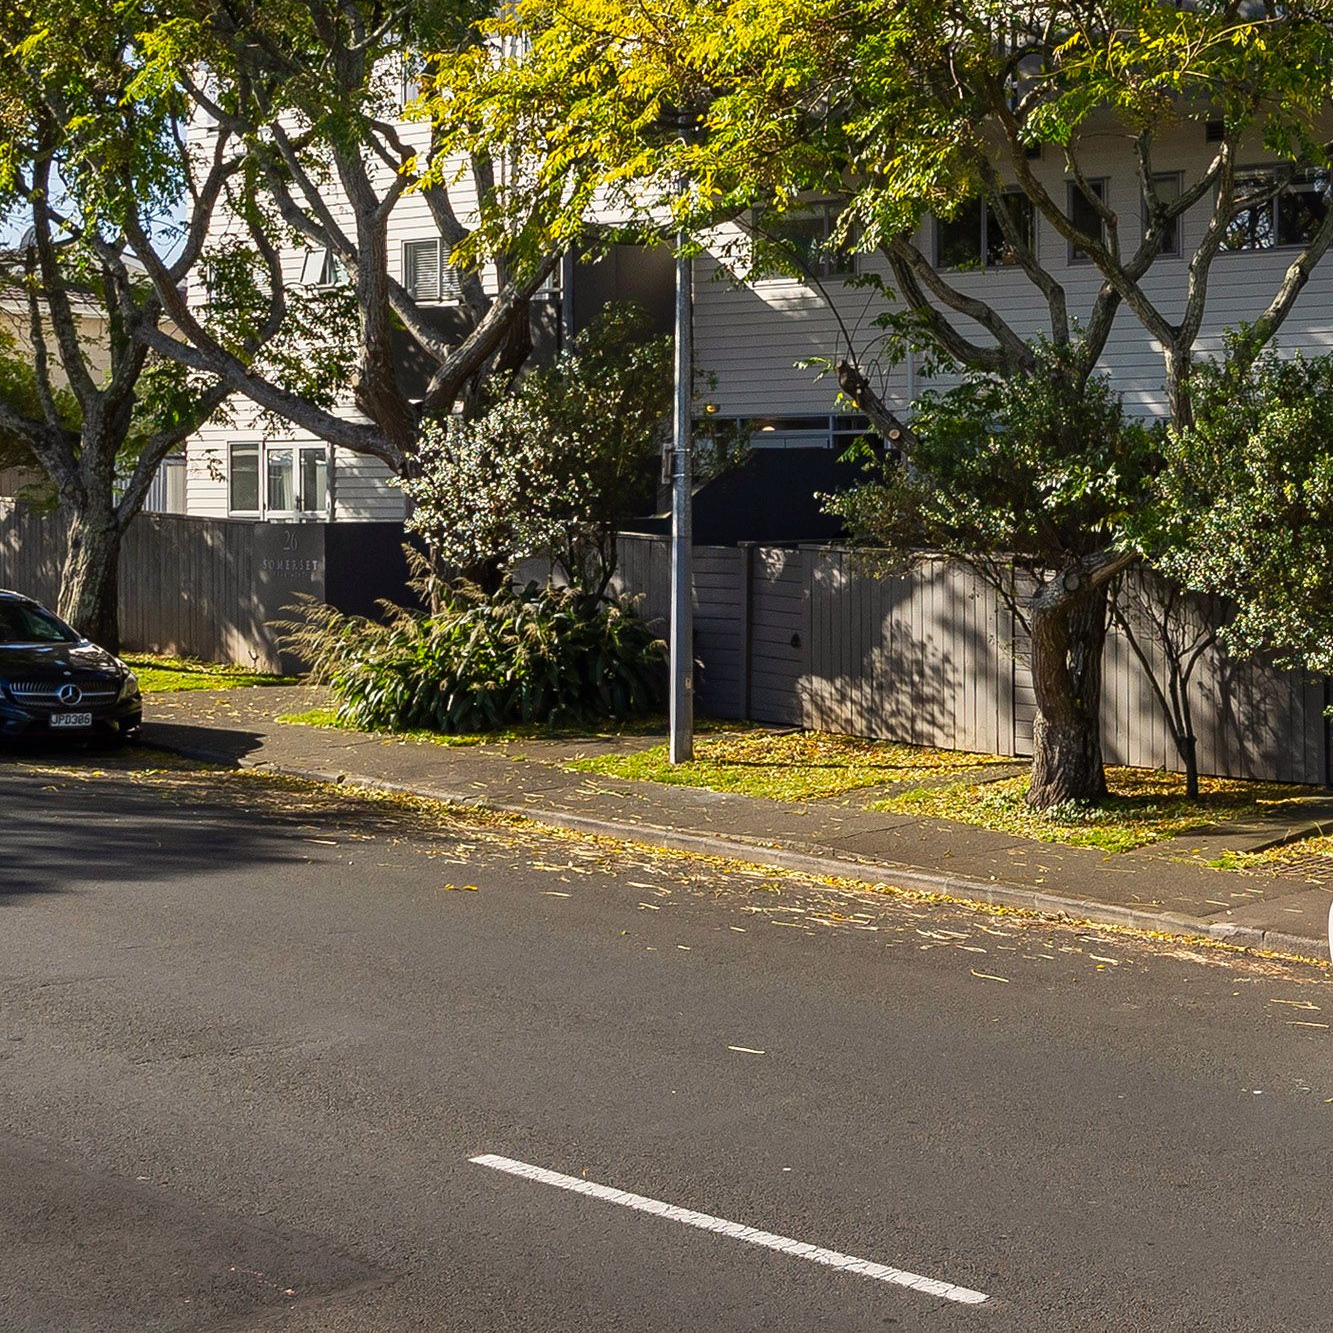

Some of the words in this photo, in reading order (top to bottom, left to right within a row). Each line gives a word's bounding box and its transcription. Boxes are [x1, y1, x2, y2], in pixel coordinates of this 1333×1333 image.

[283, 530, 298, 551] 26
[262, 559, 318, 571] SOMERSET
[51, 714, 90, 725] JPD386
